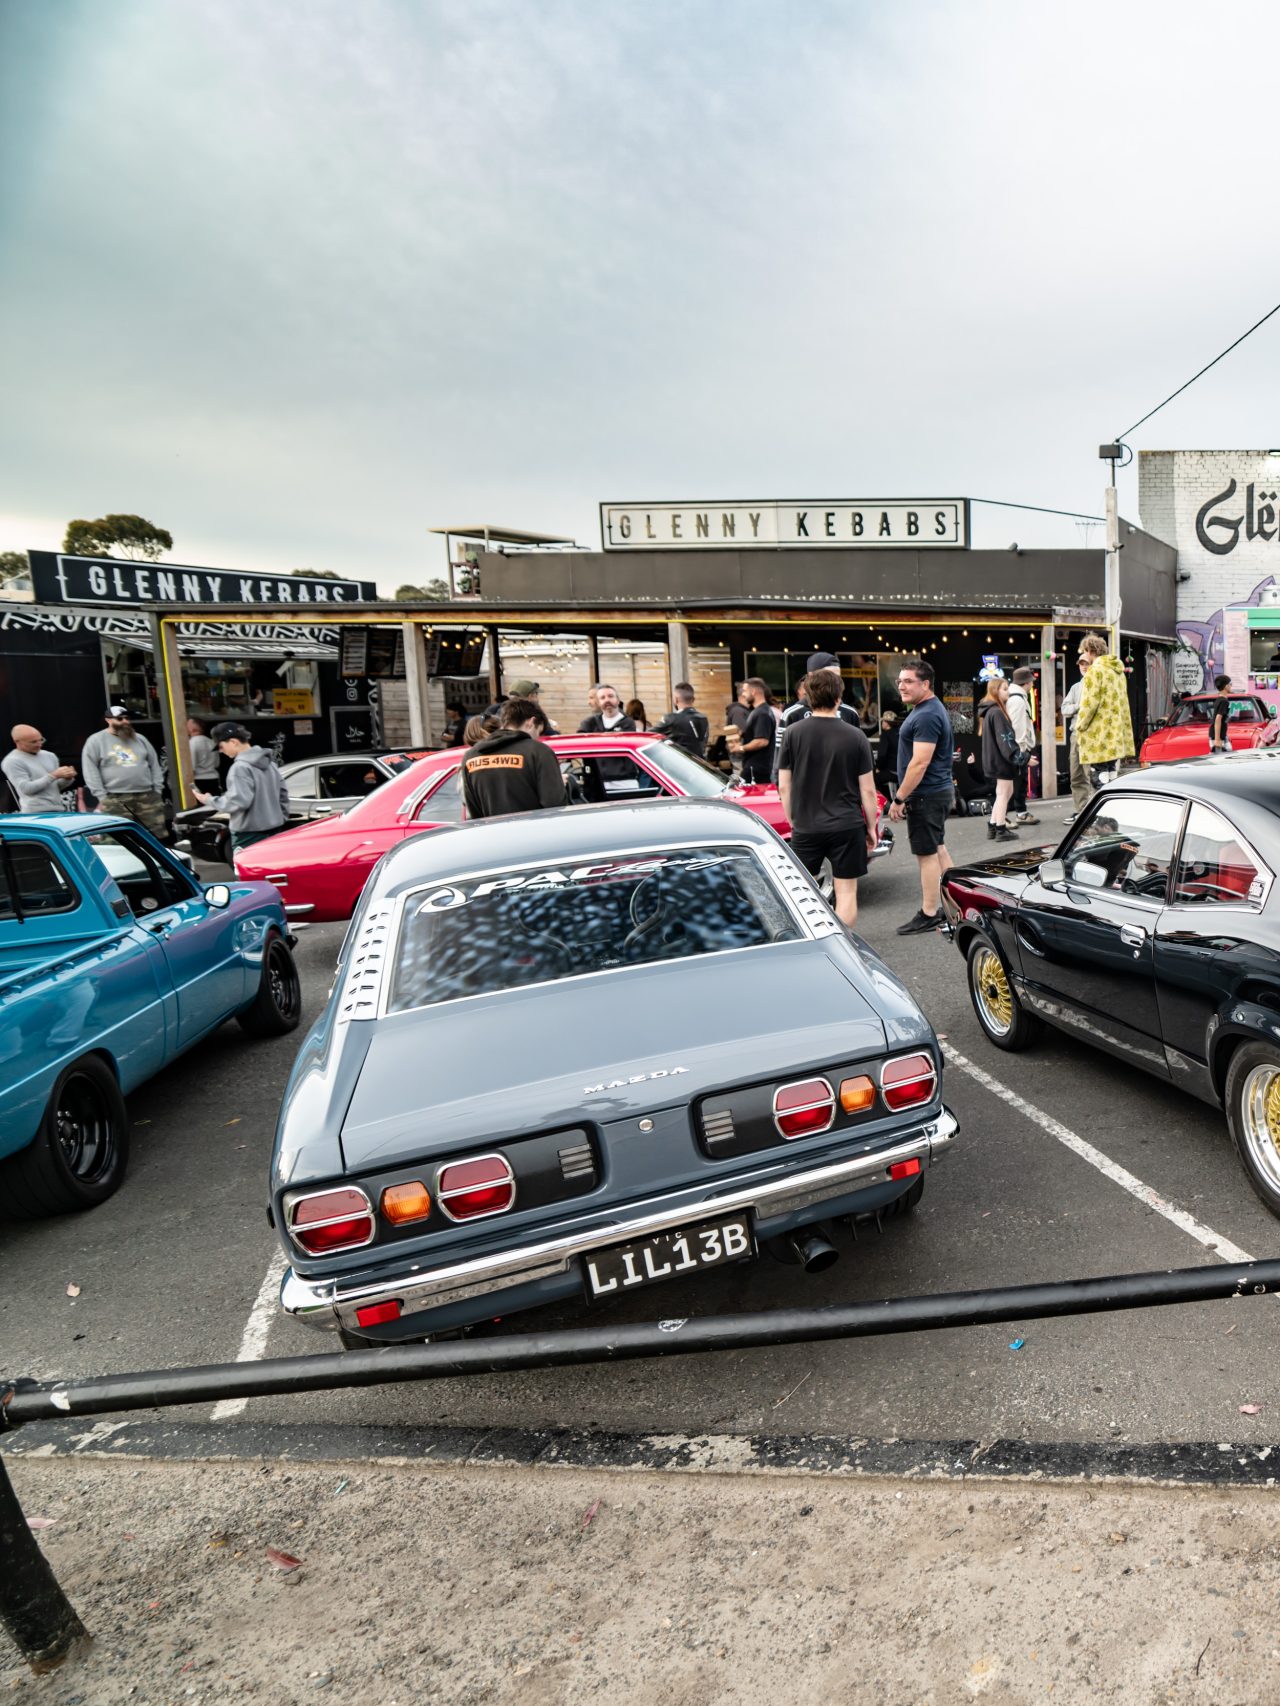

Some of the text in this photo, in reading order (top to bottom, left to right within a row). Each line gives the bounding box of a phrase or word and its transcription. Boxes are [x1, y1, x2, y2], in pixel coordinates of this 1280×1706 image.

[619, 511, 947, 539] GLENNY KEBABS
[88, 564, 223, 602] GLENNY
[492, 757, 520, 766] 4WD
[470, 864, 614, 898] PAC
[583, 1066, 690, 1095] MAZDA
[652, 1231, 682, 1245] VIC
[588, 1223, 748, 1295] LIL13B
